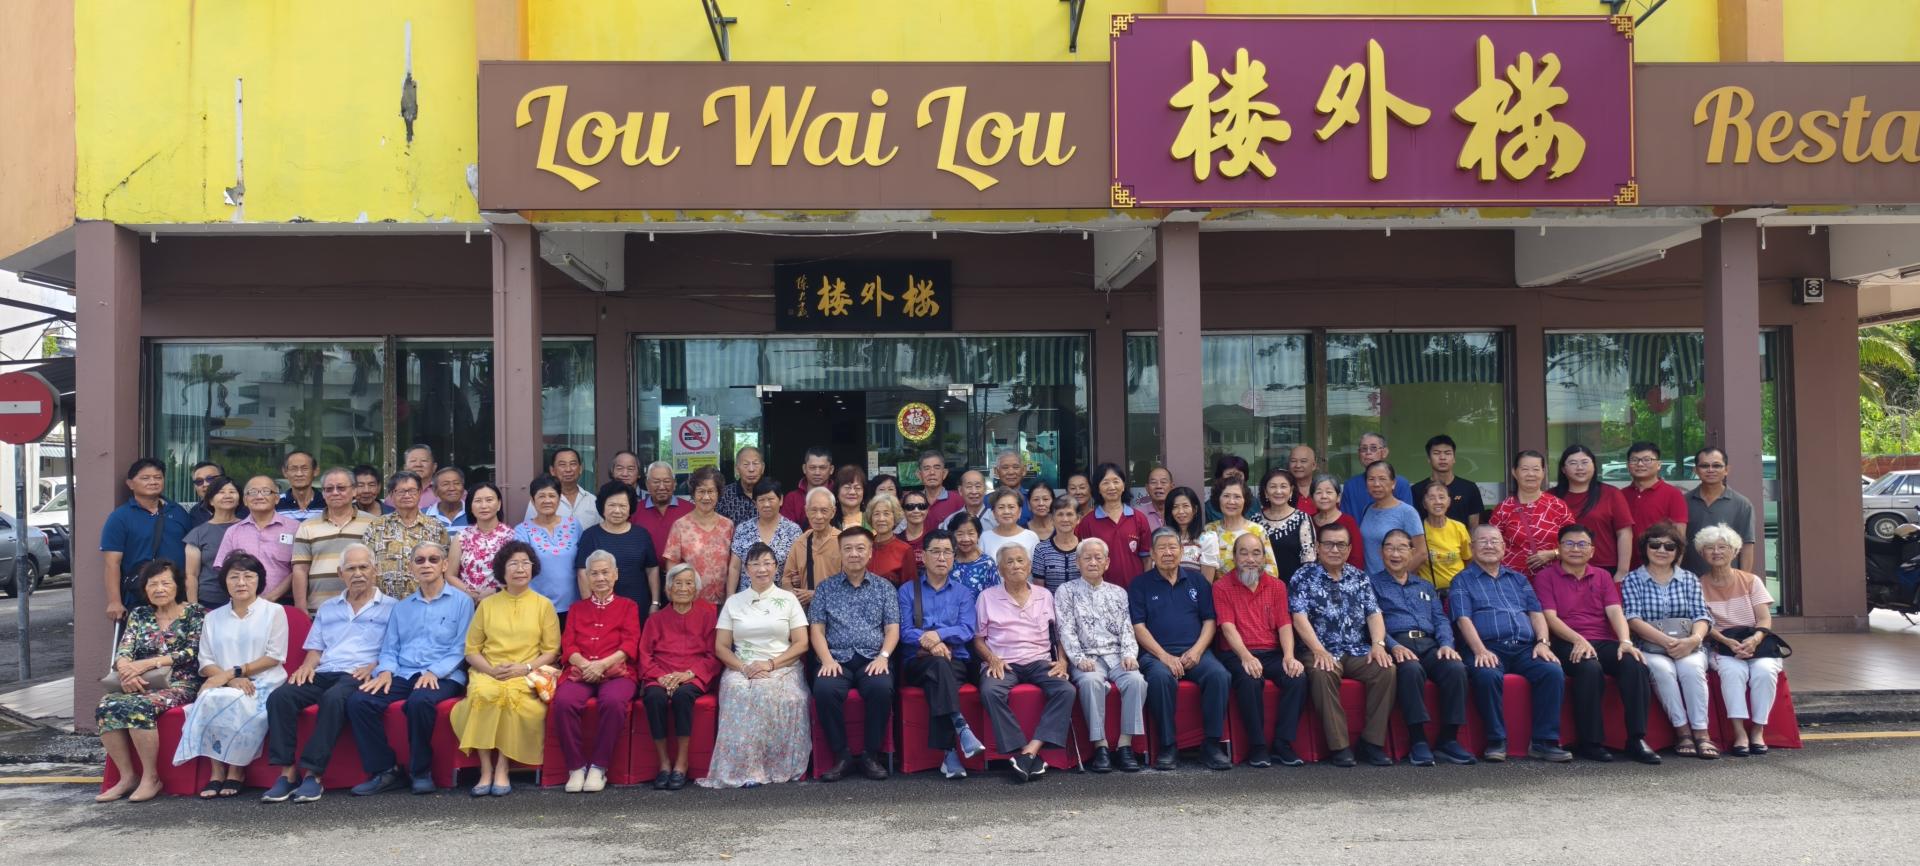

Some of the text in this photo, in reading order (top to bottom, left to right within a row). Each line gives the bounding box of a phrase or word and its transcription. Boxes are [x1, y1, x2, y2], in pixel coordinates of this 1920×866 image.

[515, 84, 1077, 191] Lou Wai Lou
[1168, 34, 1587, 181] 楼外楼
[1693, 85, 1920, 164] Resta
[817, 274, 940, 318] 楼外楼
